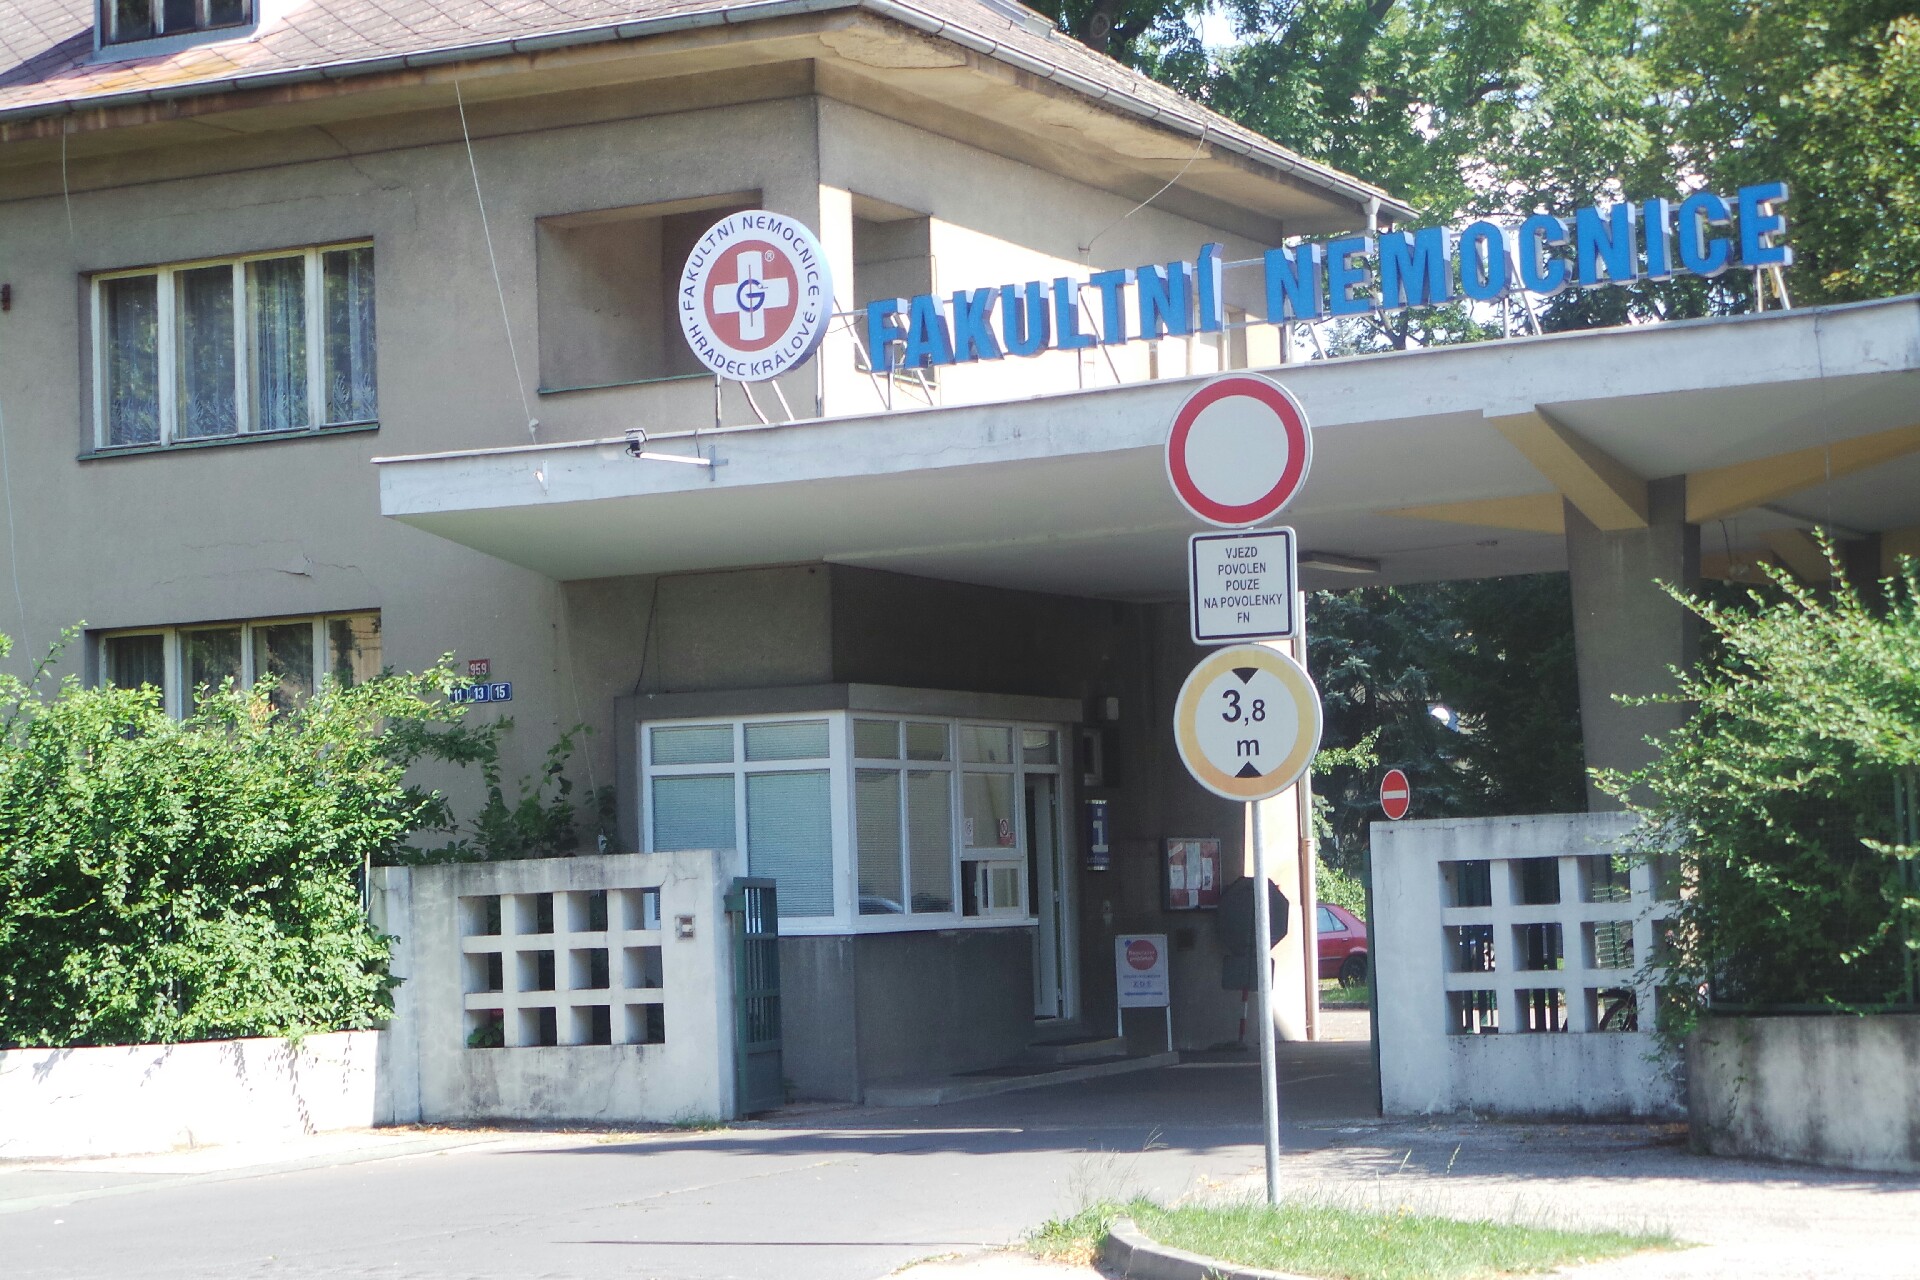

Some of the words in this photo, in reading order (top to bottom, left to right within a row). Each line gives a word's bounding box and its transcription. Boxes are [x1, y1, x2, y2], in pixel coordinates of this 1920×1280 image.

[683, 217, 735, 311] FAKULTNÍ
[742, 215, 820, 296] NEMOCNICE
[867, 242, 1225, 373] FAKULTNÍ
[1263, 181, 1792, 325] NEMOCNICE
[688, 323, 746, 376] HRADEC
[750, 311, 816, 376] KRÁLOVÉ
[1225, 546, 1258, 559] VJEZD
[1217, 562, 1267, 576] POVOLEN
[1225, 578, 1260, 592] POUZE
[1203, 597, 1218, 609] NA
[1220, 593, 1283, 608] POVOLENKY
[1237, 612, 1250, 624] FN
[470, 663, 487, 675] 959
[454, 688, 463, 701] 11
[473, 687, 484, 700] 13
[495, 685, 506, 699] 15
[1221, 689, 1266, 726] 3,8
[1236, 738, 1260, 757] m
